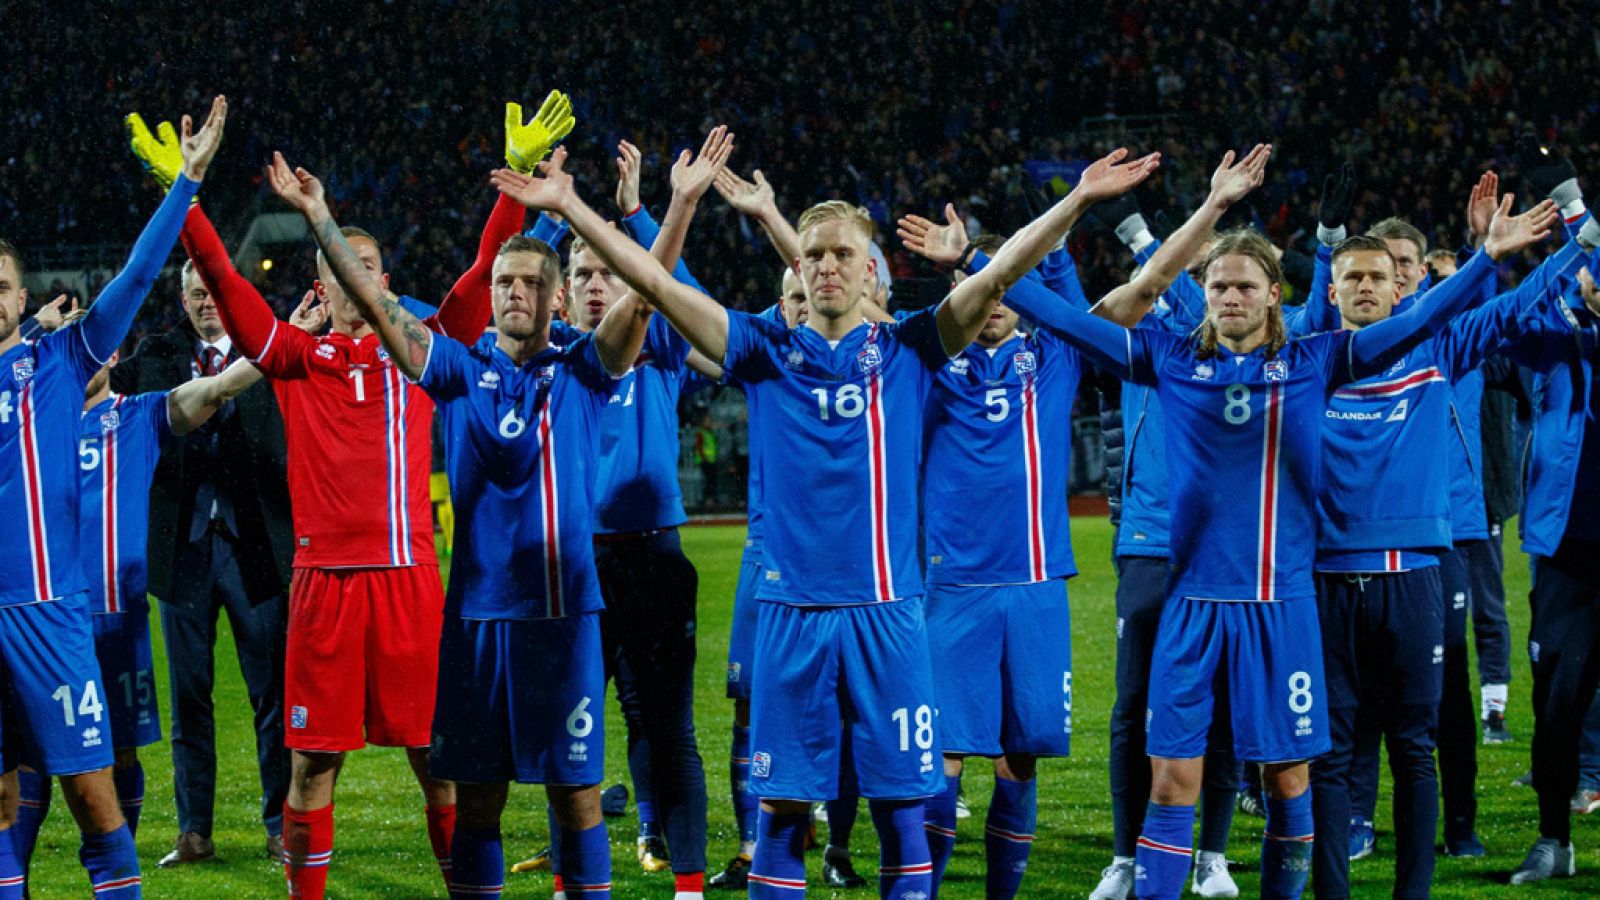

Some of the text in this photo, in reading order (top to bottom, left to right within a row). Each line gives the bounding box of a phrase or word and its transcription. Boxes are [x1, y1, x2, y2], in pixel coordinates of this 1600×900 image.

[348, 369, 366, 401] 1
[985, 388, 1010, 422] 5
[1224, 383, 1252, 425] 8
[499, 407, 526, 439] 6
[52, 680, 104, 726] 14
[119, 669, 152, 708] 15
[1288, 671, 1313, 714] 8
[566, 696, 594, 738] 6
[892, 704, 934, 752] 18
